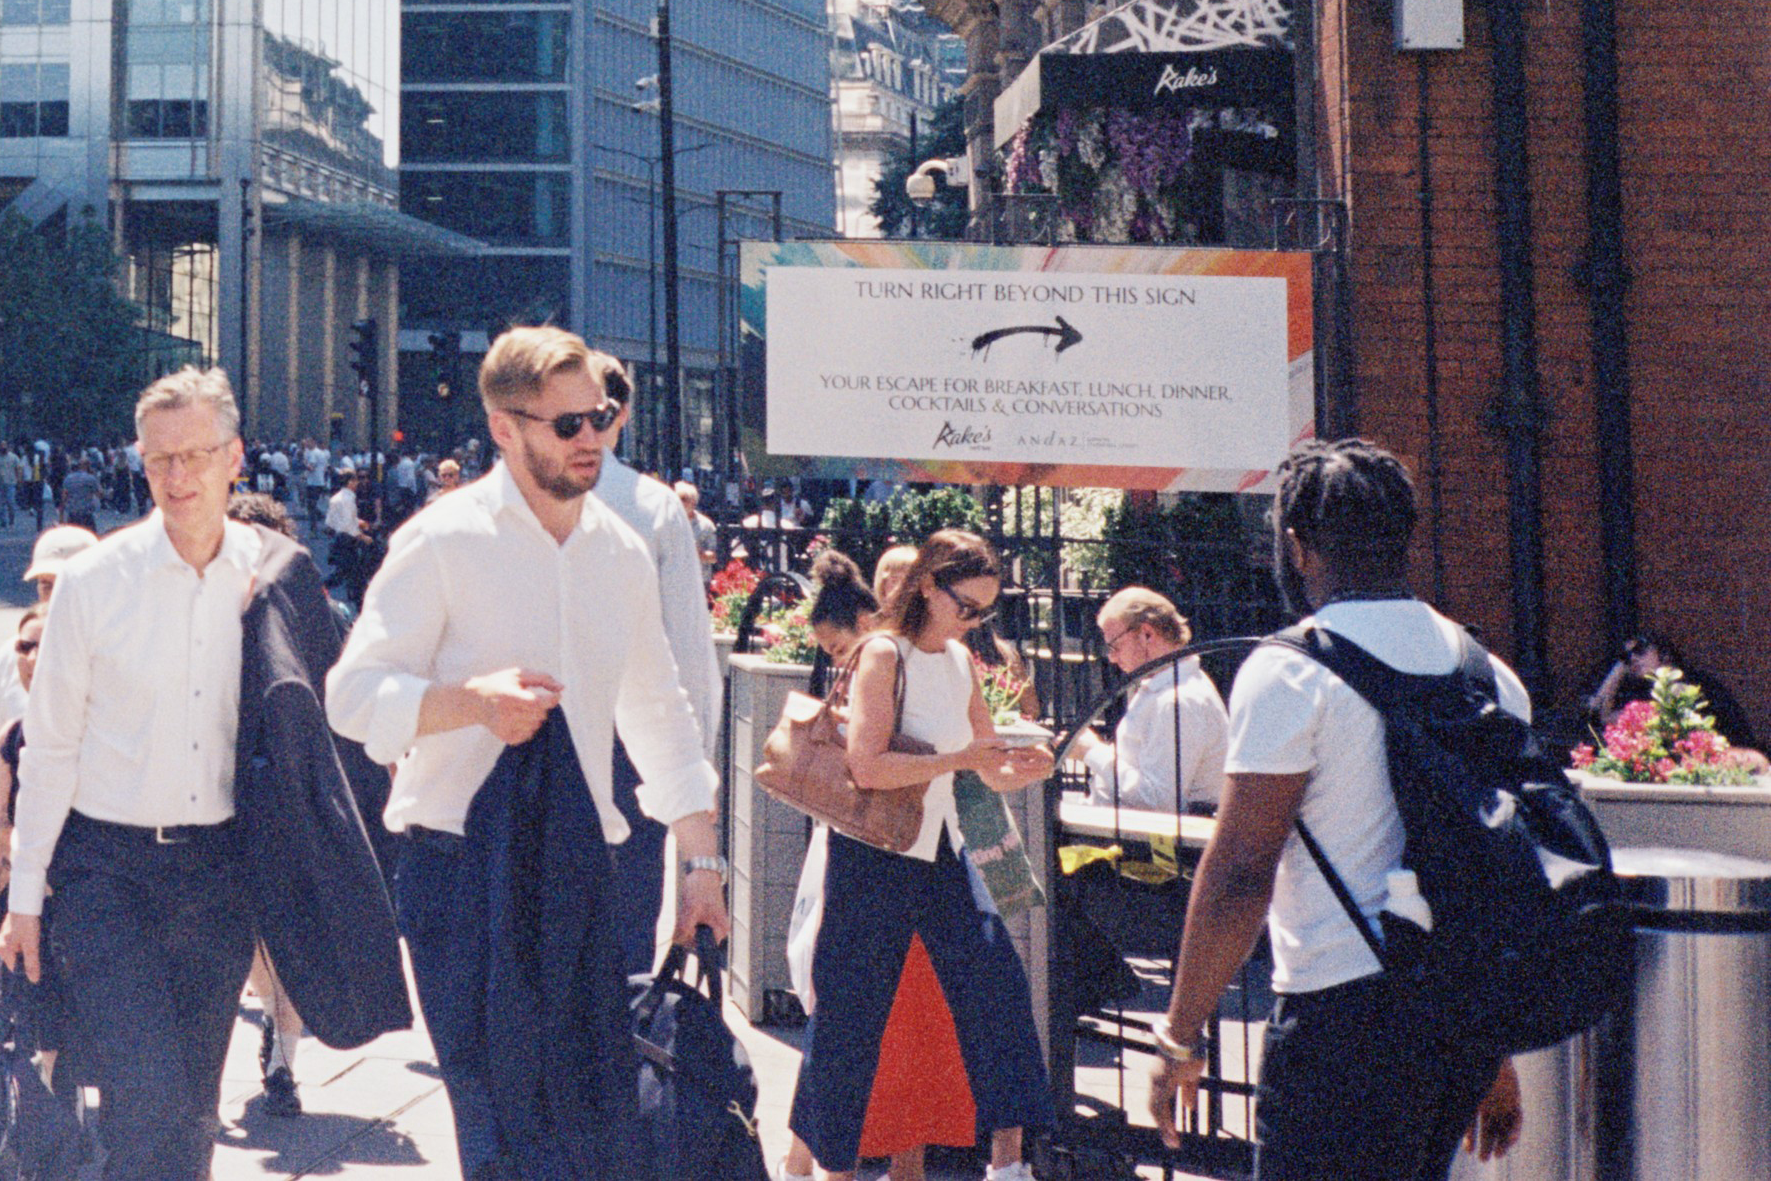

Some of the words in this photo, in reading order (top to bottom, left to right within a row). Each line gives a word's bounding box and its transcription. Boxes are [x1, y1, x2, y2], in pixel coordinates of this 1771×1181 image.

[854, 281, 913, 299] TURN
[921, 282, 988, 300] RIGHT
[994, 284, 1084, 303] BEYOND
[1091, 286, 1138, 305] THIS
[1145, 287, 1196, 306] SIGN
[820, 374, 871, 390] YOUR
[876, 375, 938, 393] ESCAPE
[944, 378, 979, 394] FOR
[1160, 384, 1233, 402] DINNER,
[888, 396, 987, 413] COCKTAILS
[992, 399, 1010, 416] &
[1012, 399, 1163, 418] CONVERSATIONS
